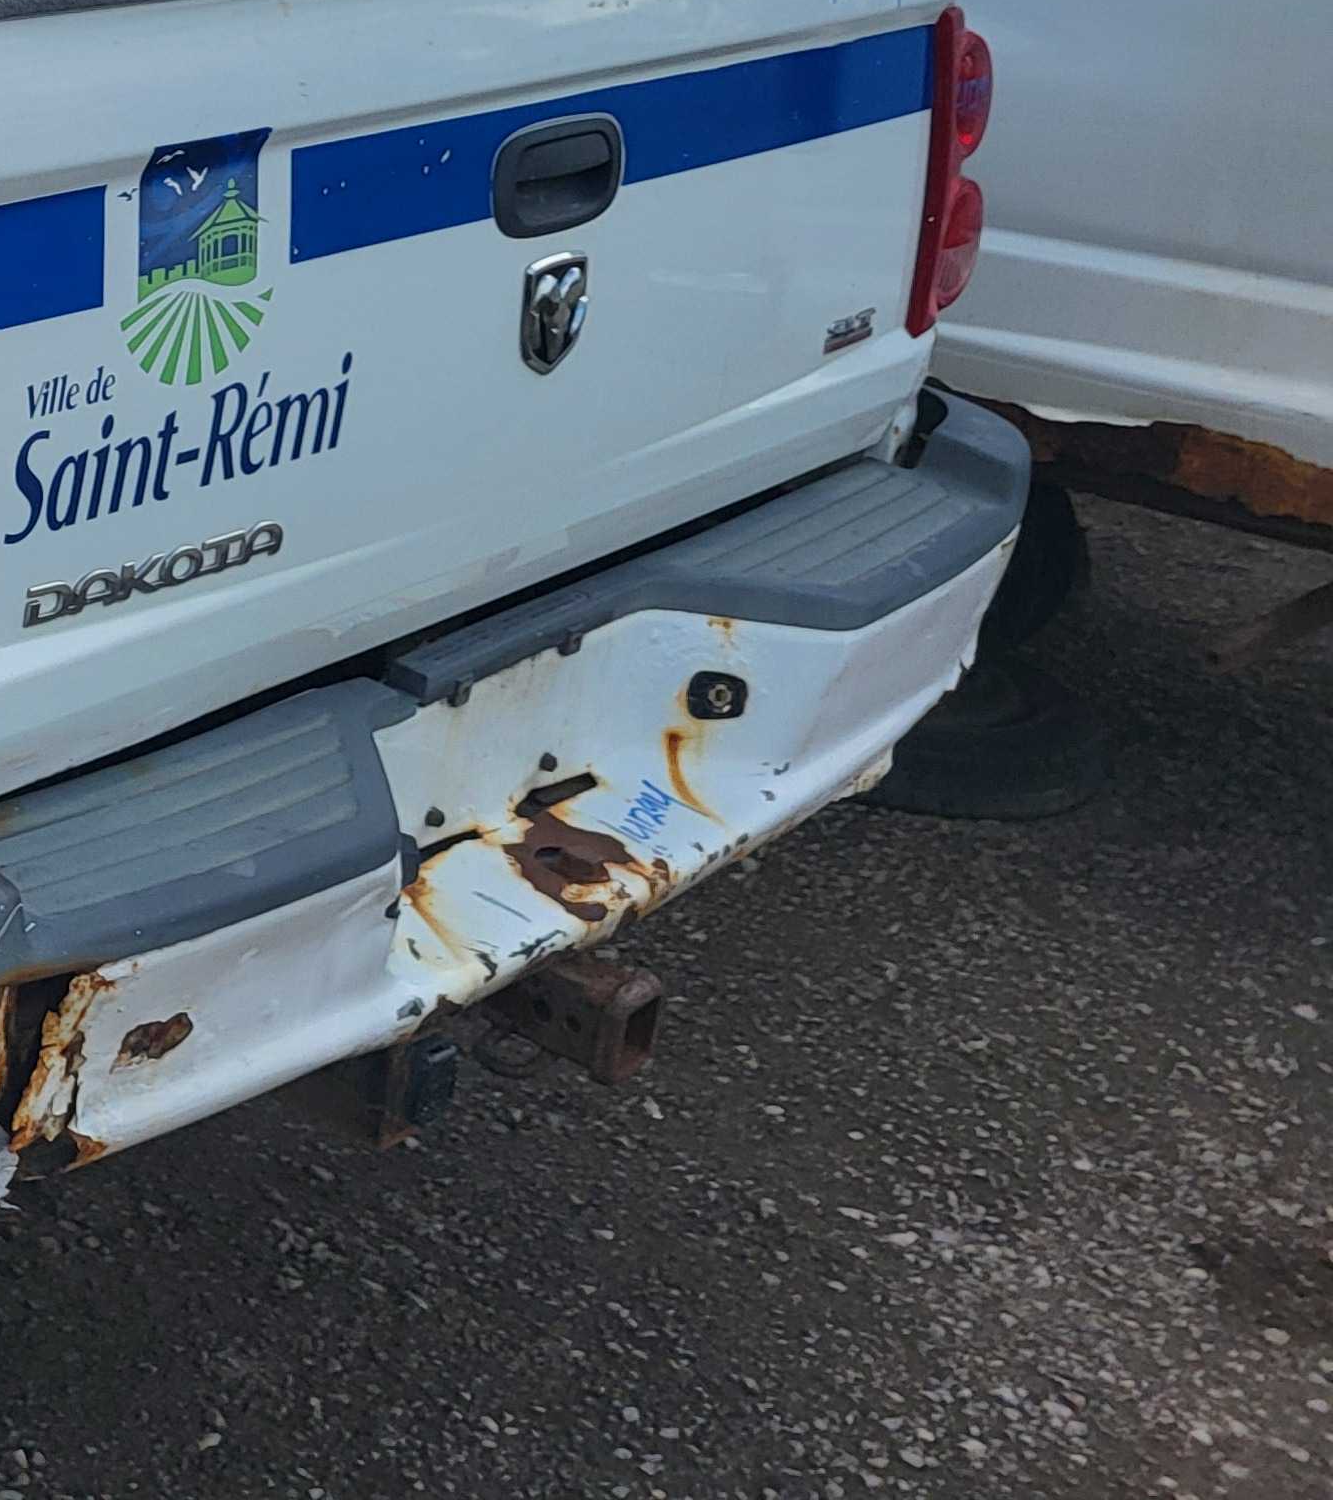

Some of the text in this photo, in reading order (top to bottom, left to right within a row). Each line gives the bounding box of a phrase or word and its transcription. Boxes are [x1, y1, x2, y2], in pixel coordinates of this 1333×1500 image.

[27, 366, 116, 418] Ville de
[3, 352, 353, 545] Saint-Rémi
[23, 520, 284, 628] DAKOTA
